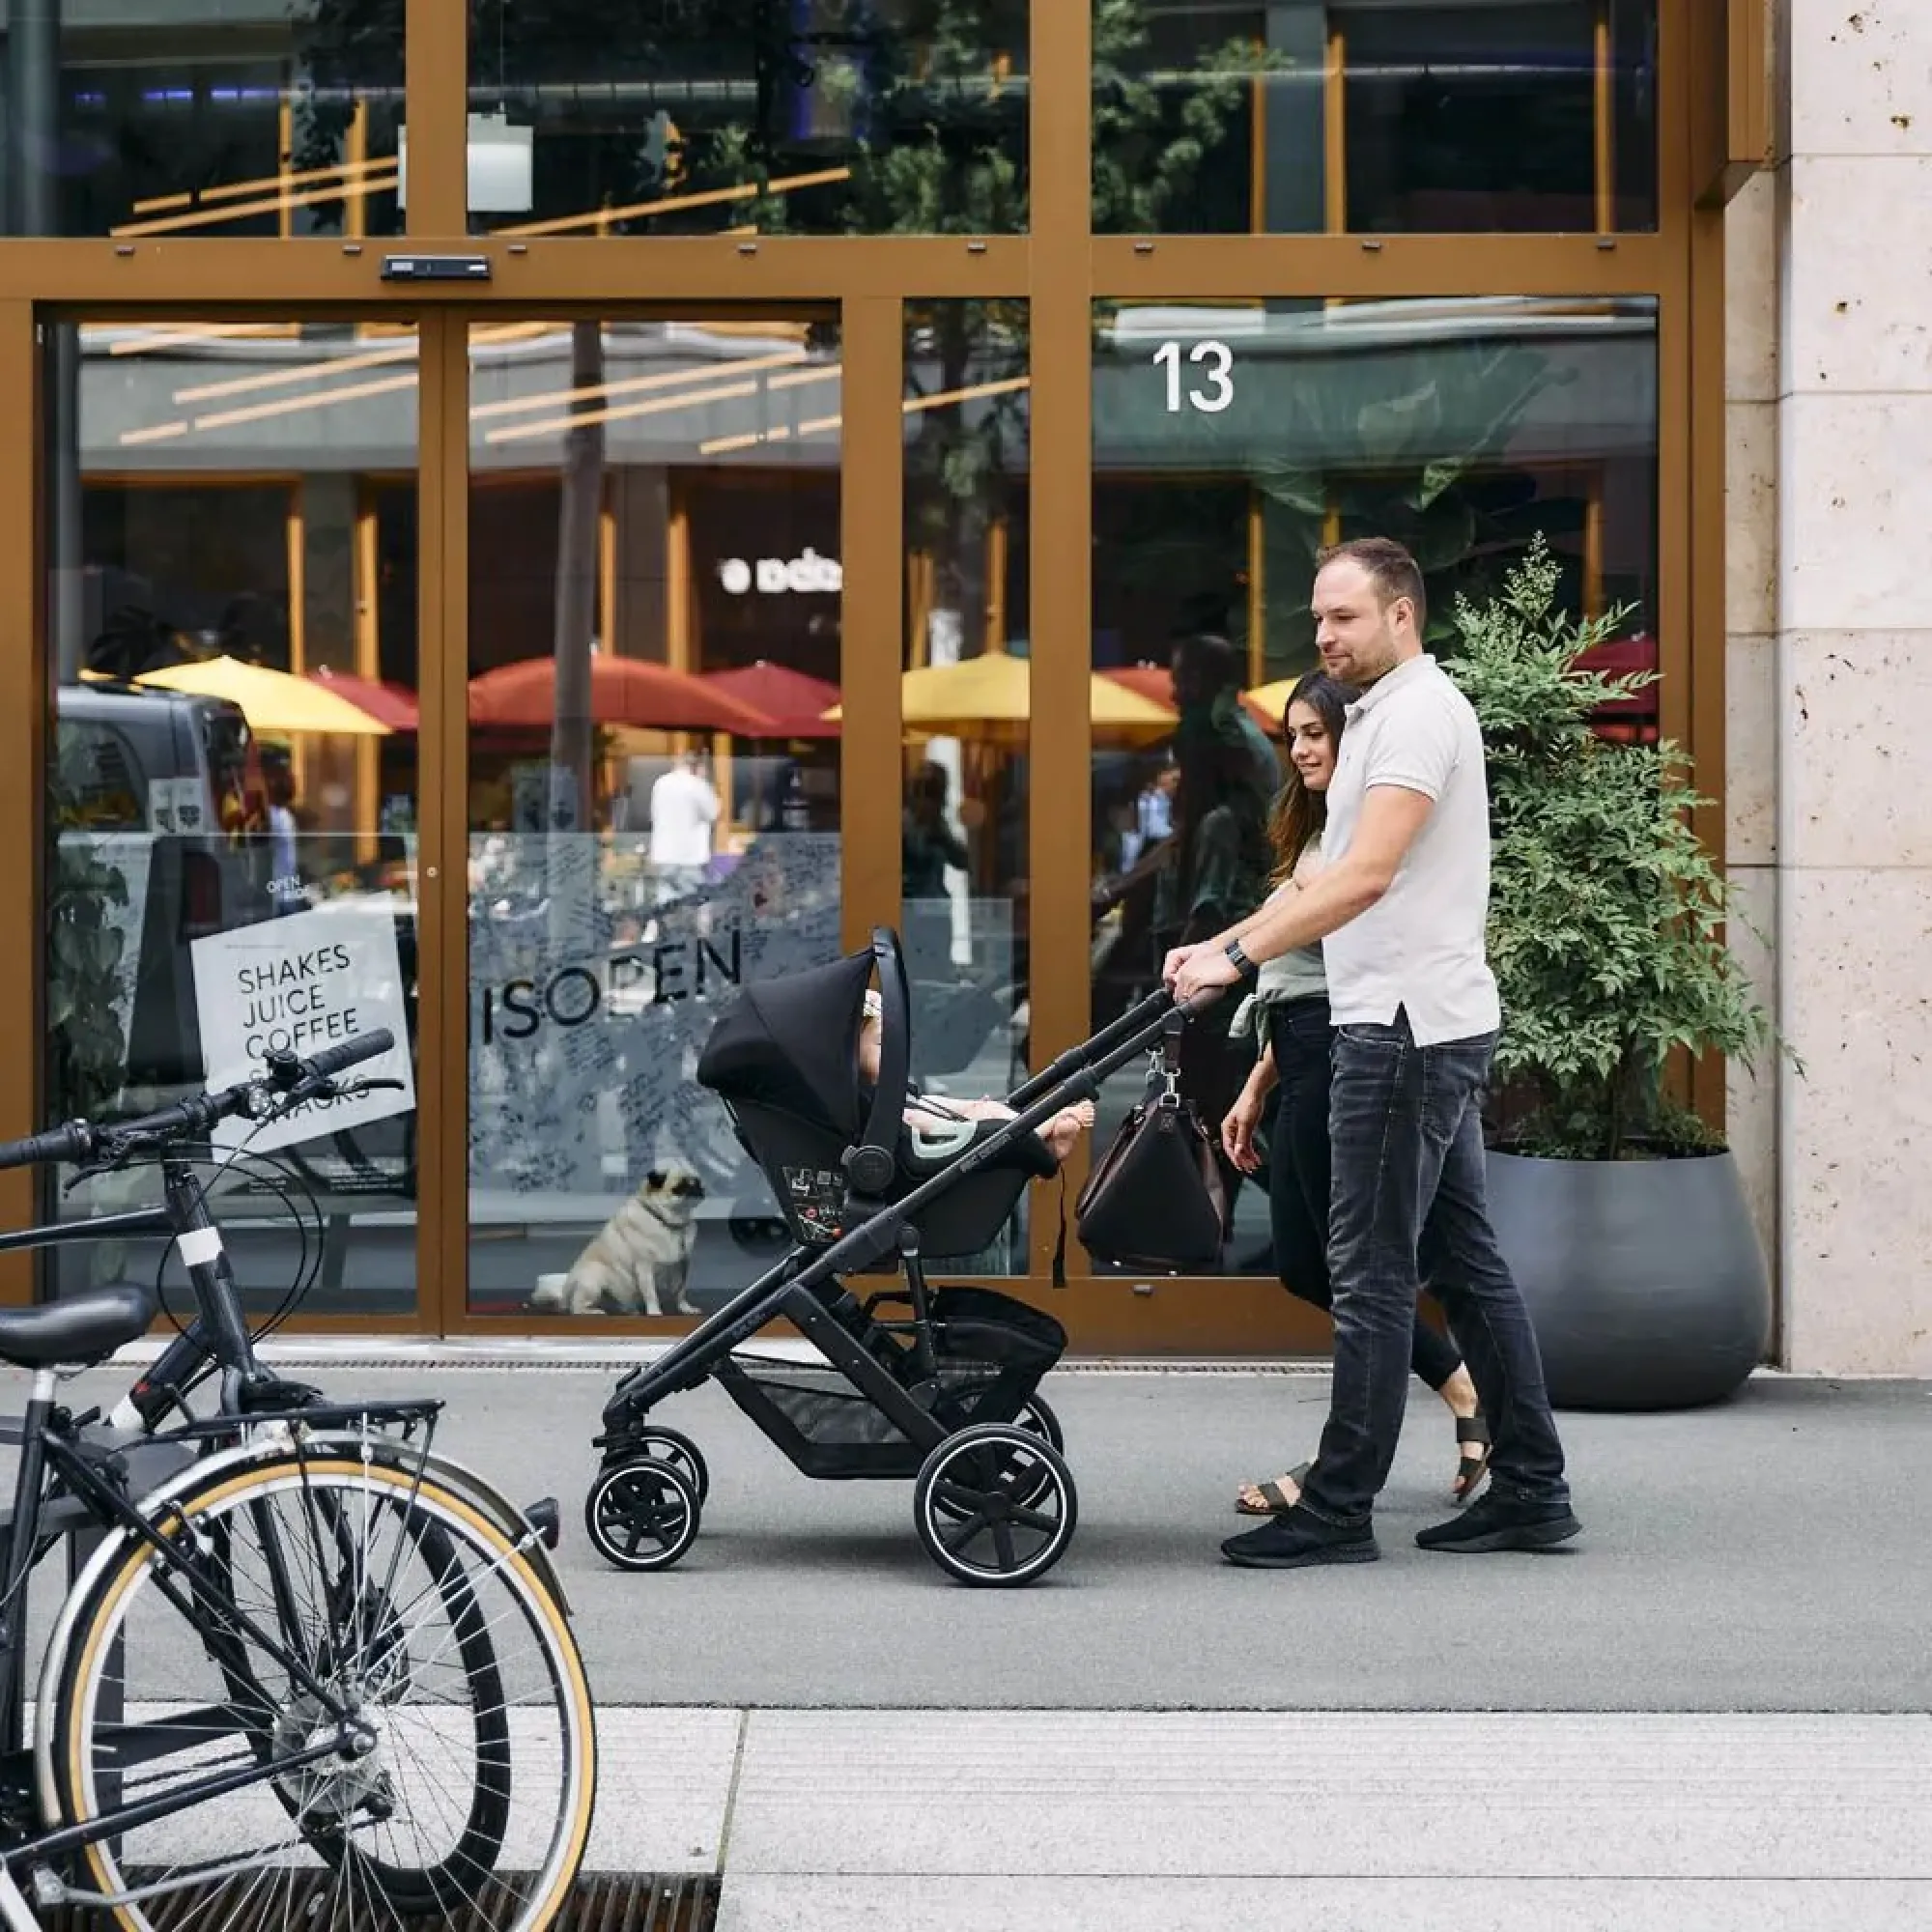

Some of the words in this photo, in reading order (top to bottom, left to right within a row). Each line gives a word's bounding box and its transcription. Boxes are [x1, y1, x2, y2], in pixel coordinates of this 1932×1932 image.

[1152, 340, 1233, 412] 13
[239, 944, 350, 994] SHAKES
[242, 984, 326, 1028] JUICE
[245, 1009, 360, 1059] COFFEE
[255, 1073, 371, 1126] AKS
